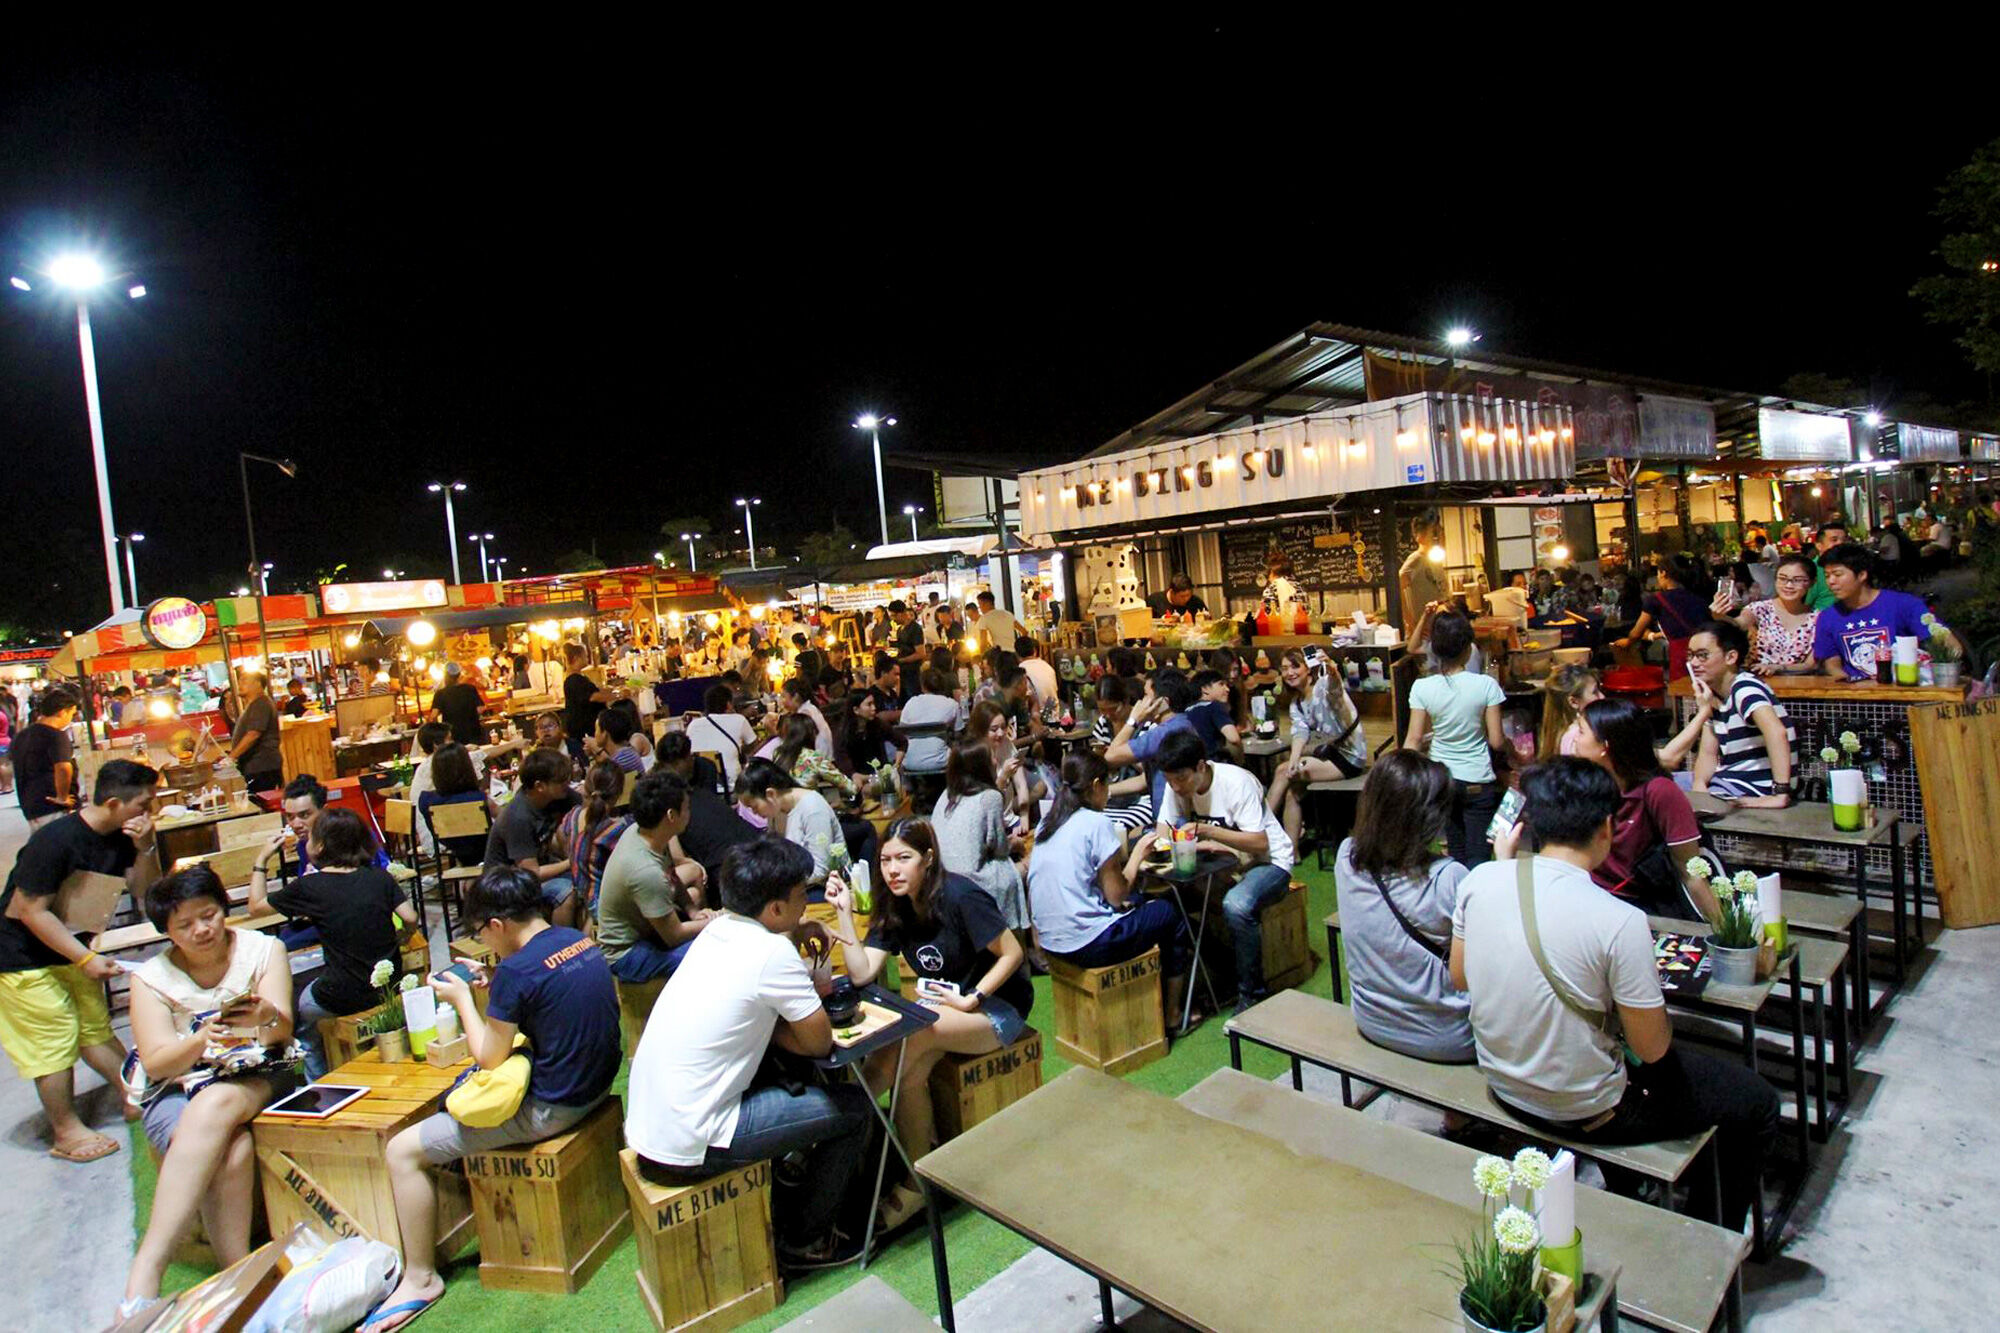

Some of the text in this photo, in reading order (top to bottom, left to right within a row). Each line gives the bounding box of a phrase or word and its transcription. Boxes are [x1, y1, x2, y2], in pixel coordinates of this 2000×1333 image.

[1076, 449, 1285, 509] ME BING SU
[1101, 970, 1116, 990] ME
[1118, 961, 1147, 984] BING
[963, 1040, 1040, 1087] ME BING SU
[466, 1155, 489, 1177] ME
[492, 1156, 533, 1178] BING
[535, 1157, 556, 1179] SU
[284, 1167, 308, 1194] ME
[304, 1188, 339, 1230] BING
[657, 1164, 766, 1231] ME BING SU
